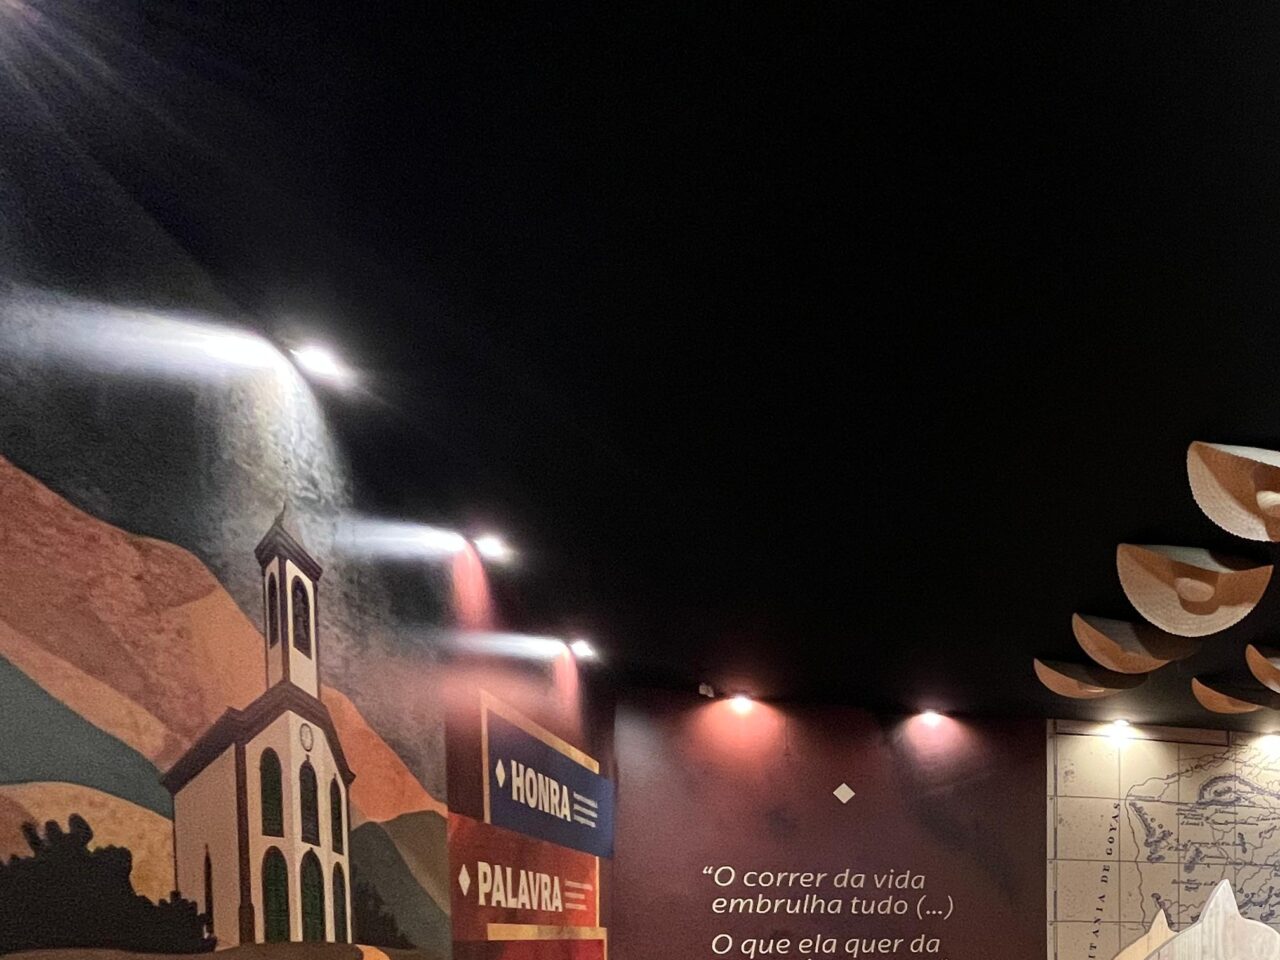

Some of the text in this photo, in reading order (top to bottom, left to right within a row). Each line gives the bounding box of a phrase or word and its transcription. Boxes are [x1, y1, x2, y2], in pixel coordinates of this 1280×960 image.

[510, 759, 572, 822] HONRA
[1105, 802, 1120, 856] GOYAS
[477, 861, 563, 912] PALAVRA
[702, 866, 926, 889] “O correr da vida
[711, 894, 954, 920] embrulha tudo (...)
[711, 934, 941, 959] O que ela quer da
